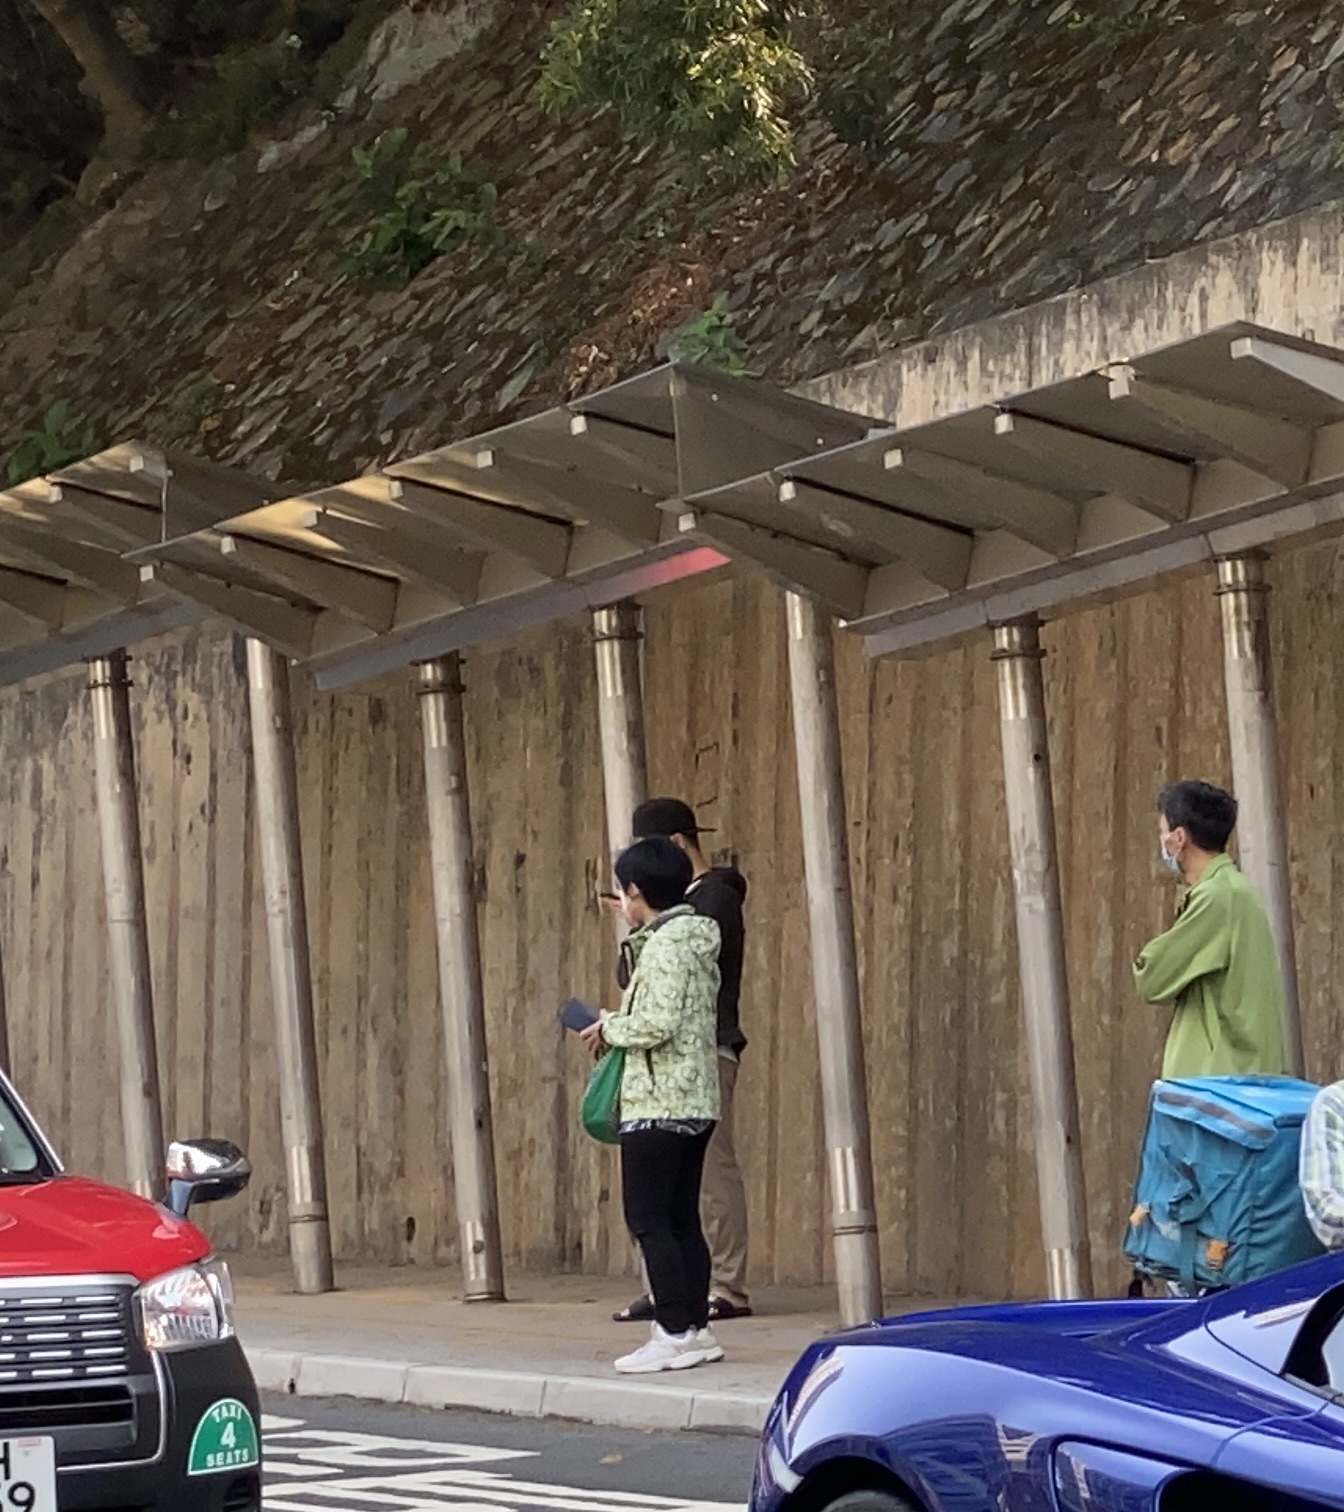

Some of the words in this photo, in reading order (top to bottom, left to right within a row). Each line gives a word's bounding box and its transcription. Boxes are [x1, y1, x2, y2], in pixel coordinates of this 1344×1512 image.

[211, 1404, 242, 1423] TAXI
[220, 1421, 237, 1449] 4
[206, 1448, 249, 1467] SEATS
